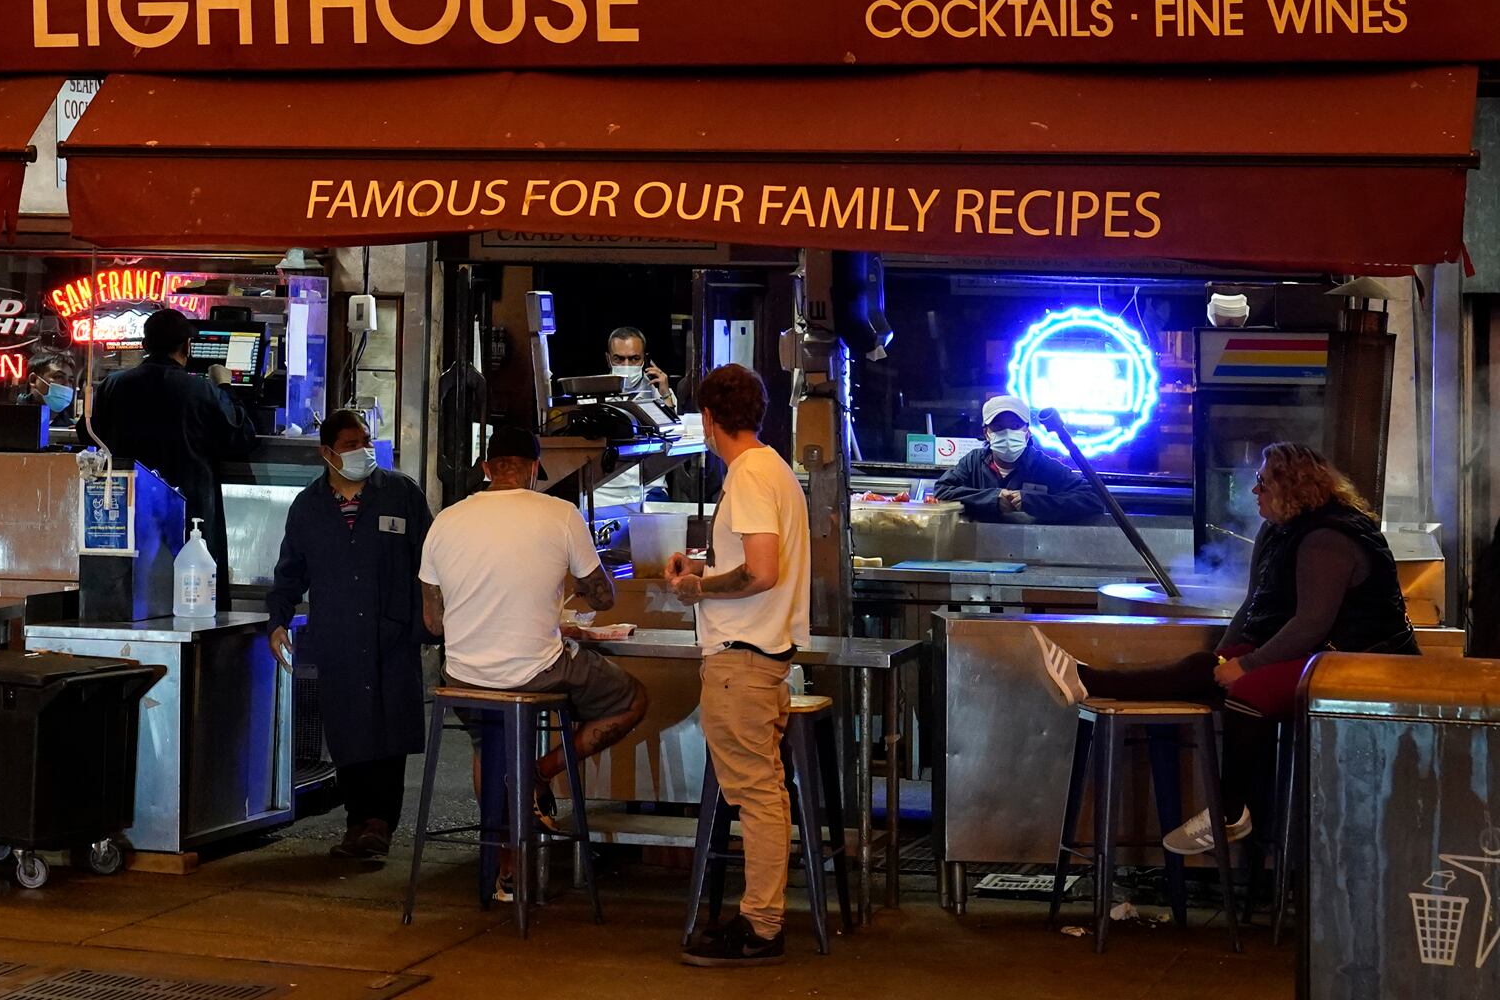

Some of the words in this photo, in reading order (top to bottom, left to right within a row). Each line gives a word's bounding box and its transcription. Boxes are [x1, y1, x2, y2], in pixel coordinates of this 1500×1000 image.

[64, 99, 90, 119] COC
[306, 179, 508, 219] FAMOUS
[521, 180, 620, 217] FOR
[633, 181, 745, 223] OUR
[758, 184, 940, 233] FAMILY
[955, 189, 1161, 239] RECIPES
[52, 276, 92, 317] SAN
